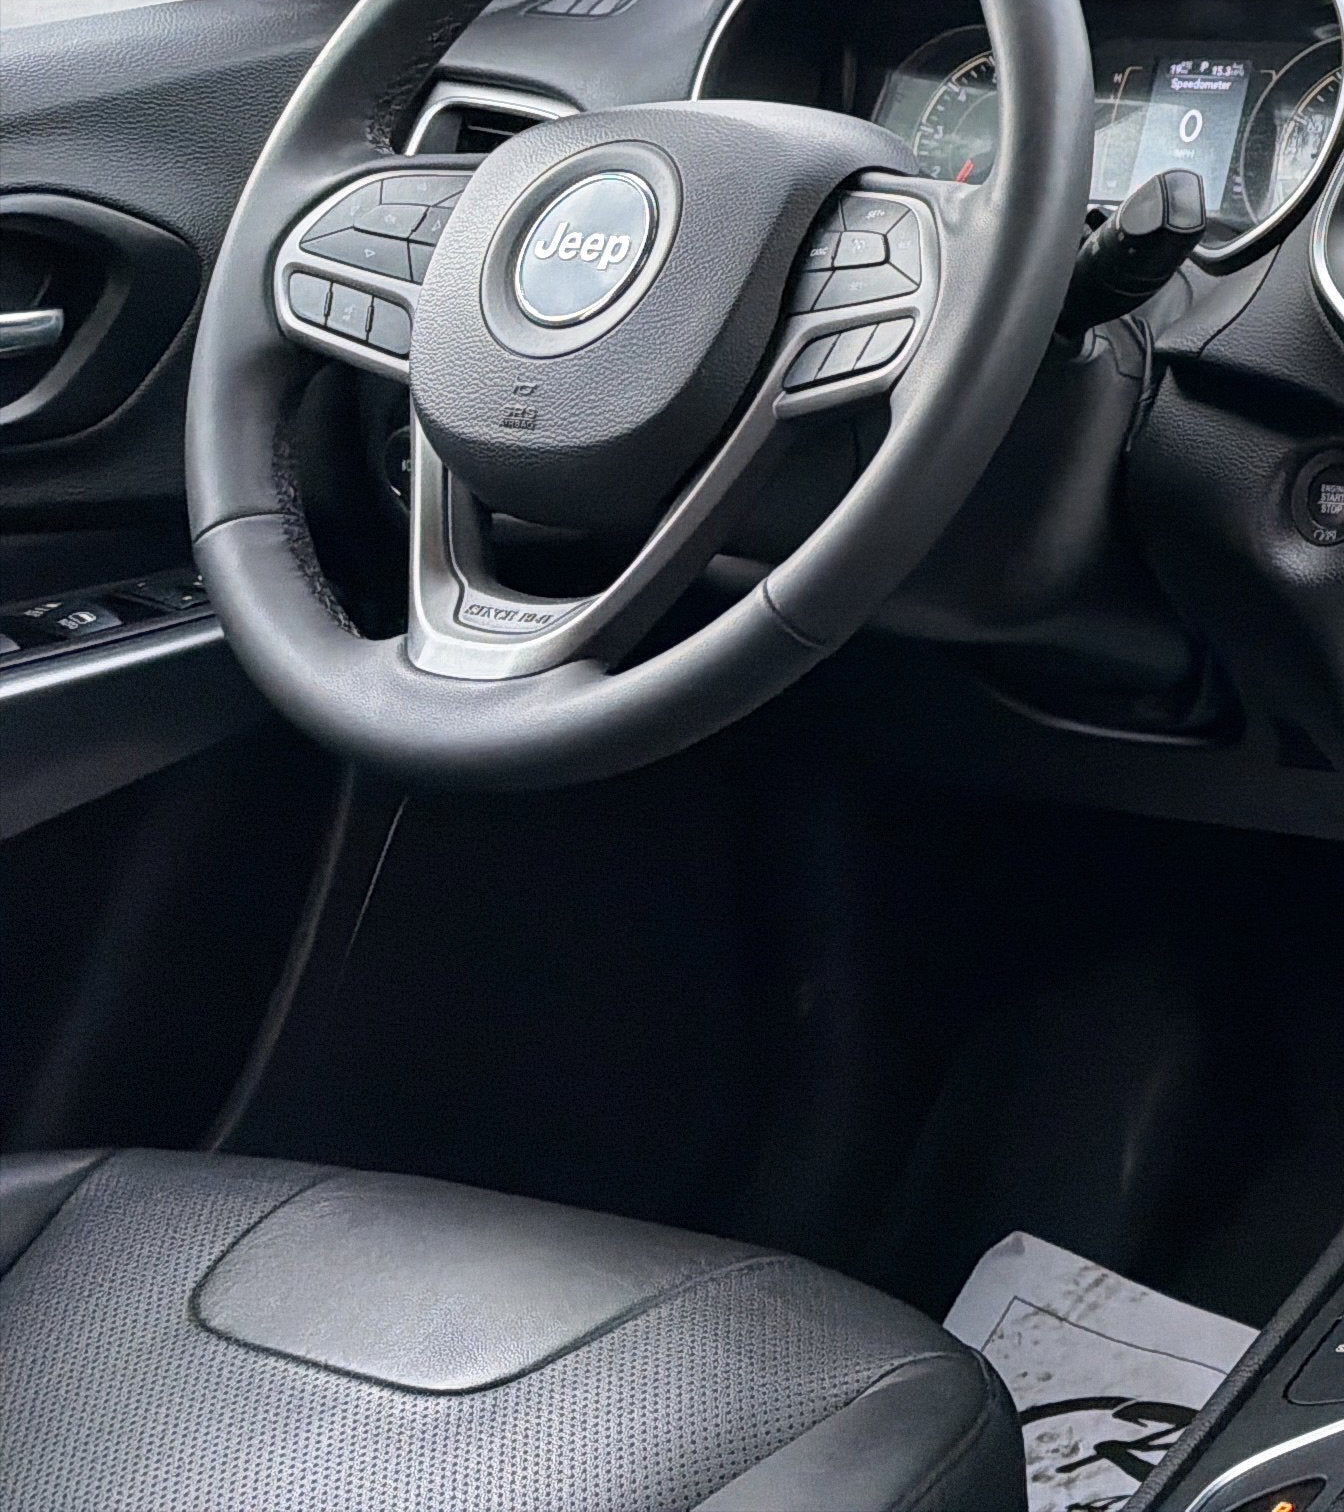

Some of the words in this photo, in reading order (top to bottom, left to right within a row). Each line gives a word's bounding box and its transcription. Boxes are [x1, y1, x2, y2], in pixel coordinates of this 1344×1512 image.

[1170, 78, 1232, 90] Speedometer
[1179, 109, 1203, 143] 0
[534, 221, 631, 270] Jeep
[1320, 503, 1343, 514] STOP
